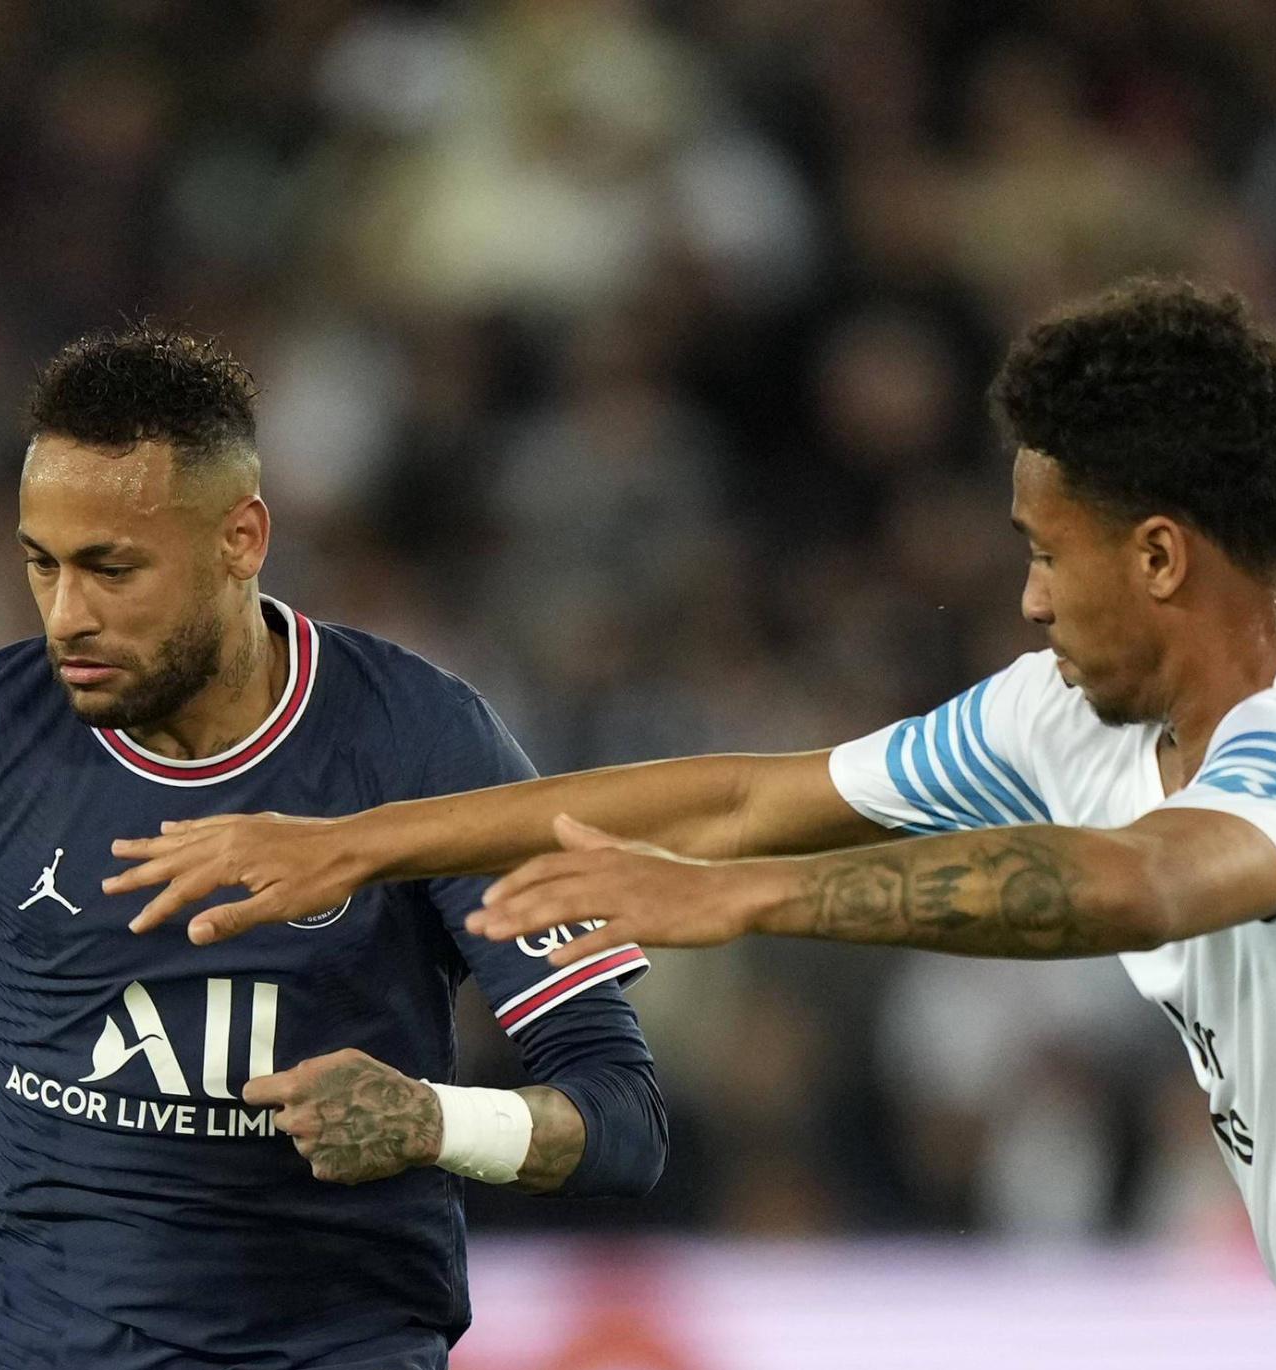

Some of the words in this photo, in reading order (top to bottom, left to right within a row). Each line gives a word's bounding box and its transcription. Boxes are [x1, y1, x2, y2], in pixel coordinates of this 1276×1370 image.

[5, 1065, 107, 1123] ACCOR
[117, 1098, 197, 1135] LIVE
[207, 1108, 276, 1137] LIMI
